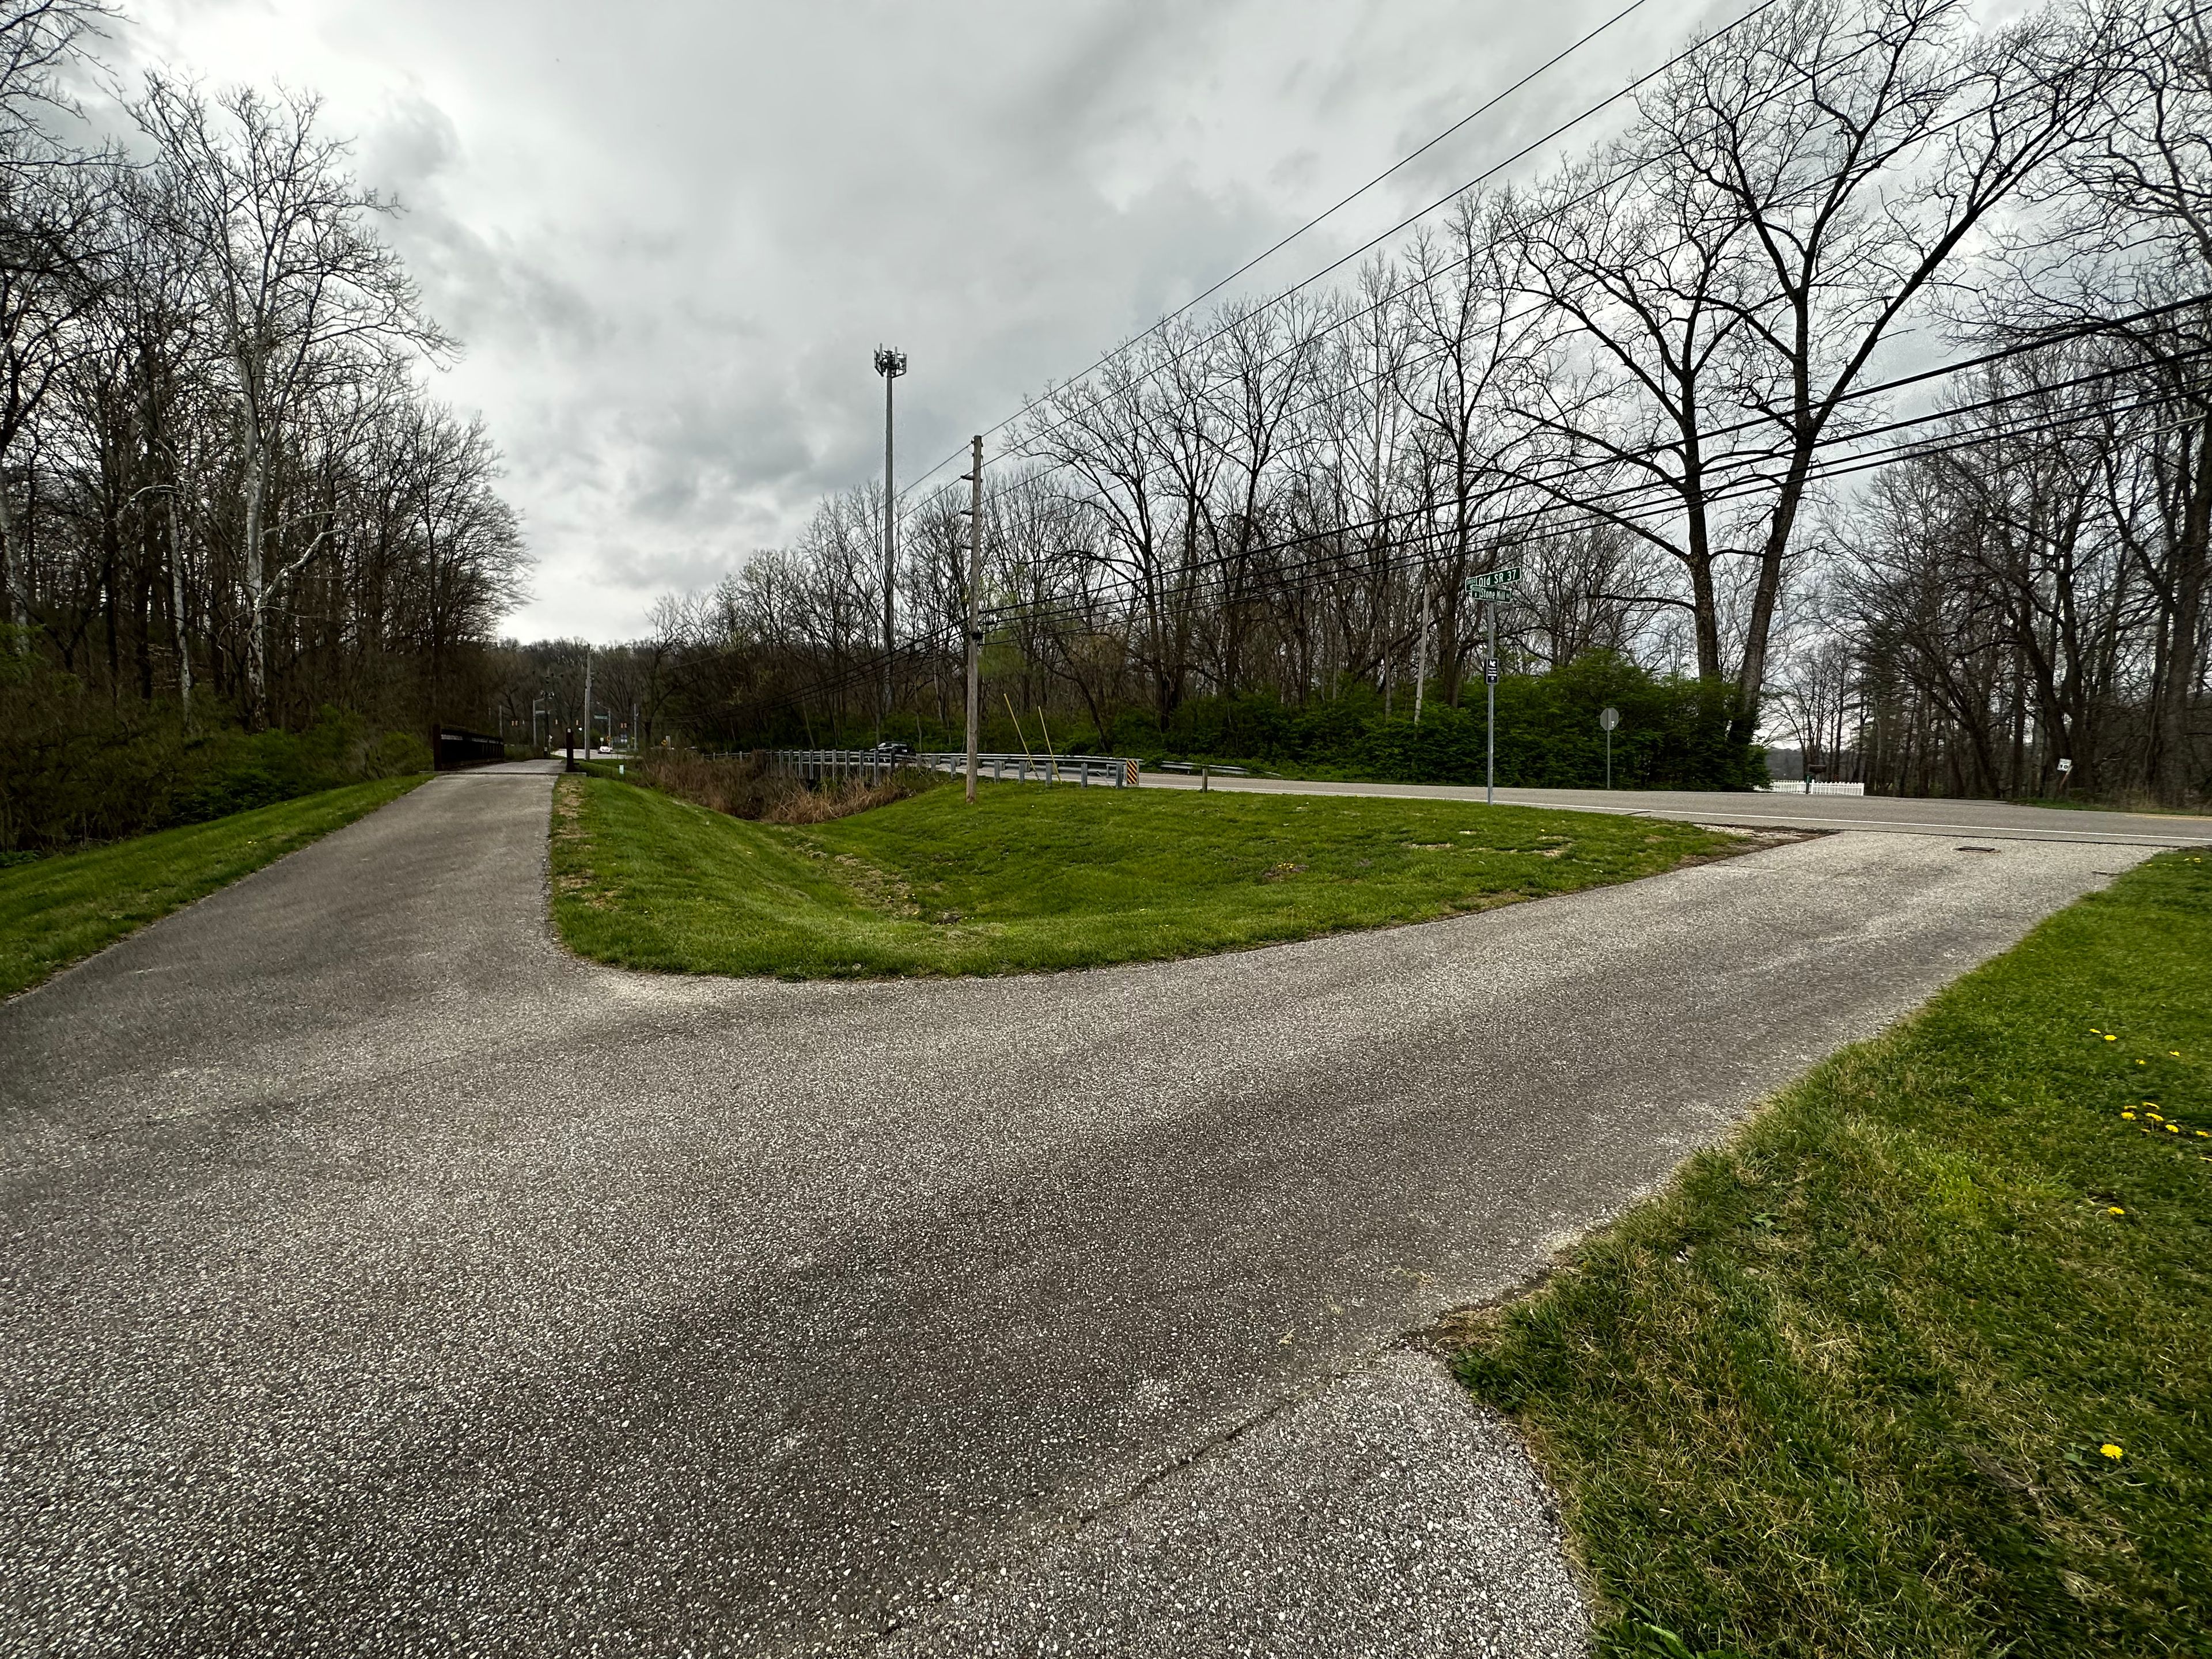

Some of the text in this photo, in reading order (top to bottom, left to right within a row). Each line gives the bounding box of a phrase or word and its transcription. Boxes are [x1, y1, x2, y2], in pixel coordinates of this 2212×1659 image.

[1479, 569, 1516, 587] Old SR 37
[1480, 588, 1495, 599] Stone
[1496, 590, 1505, 600] Mill
